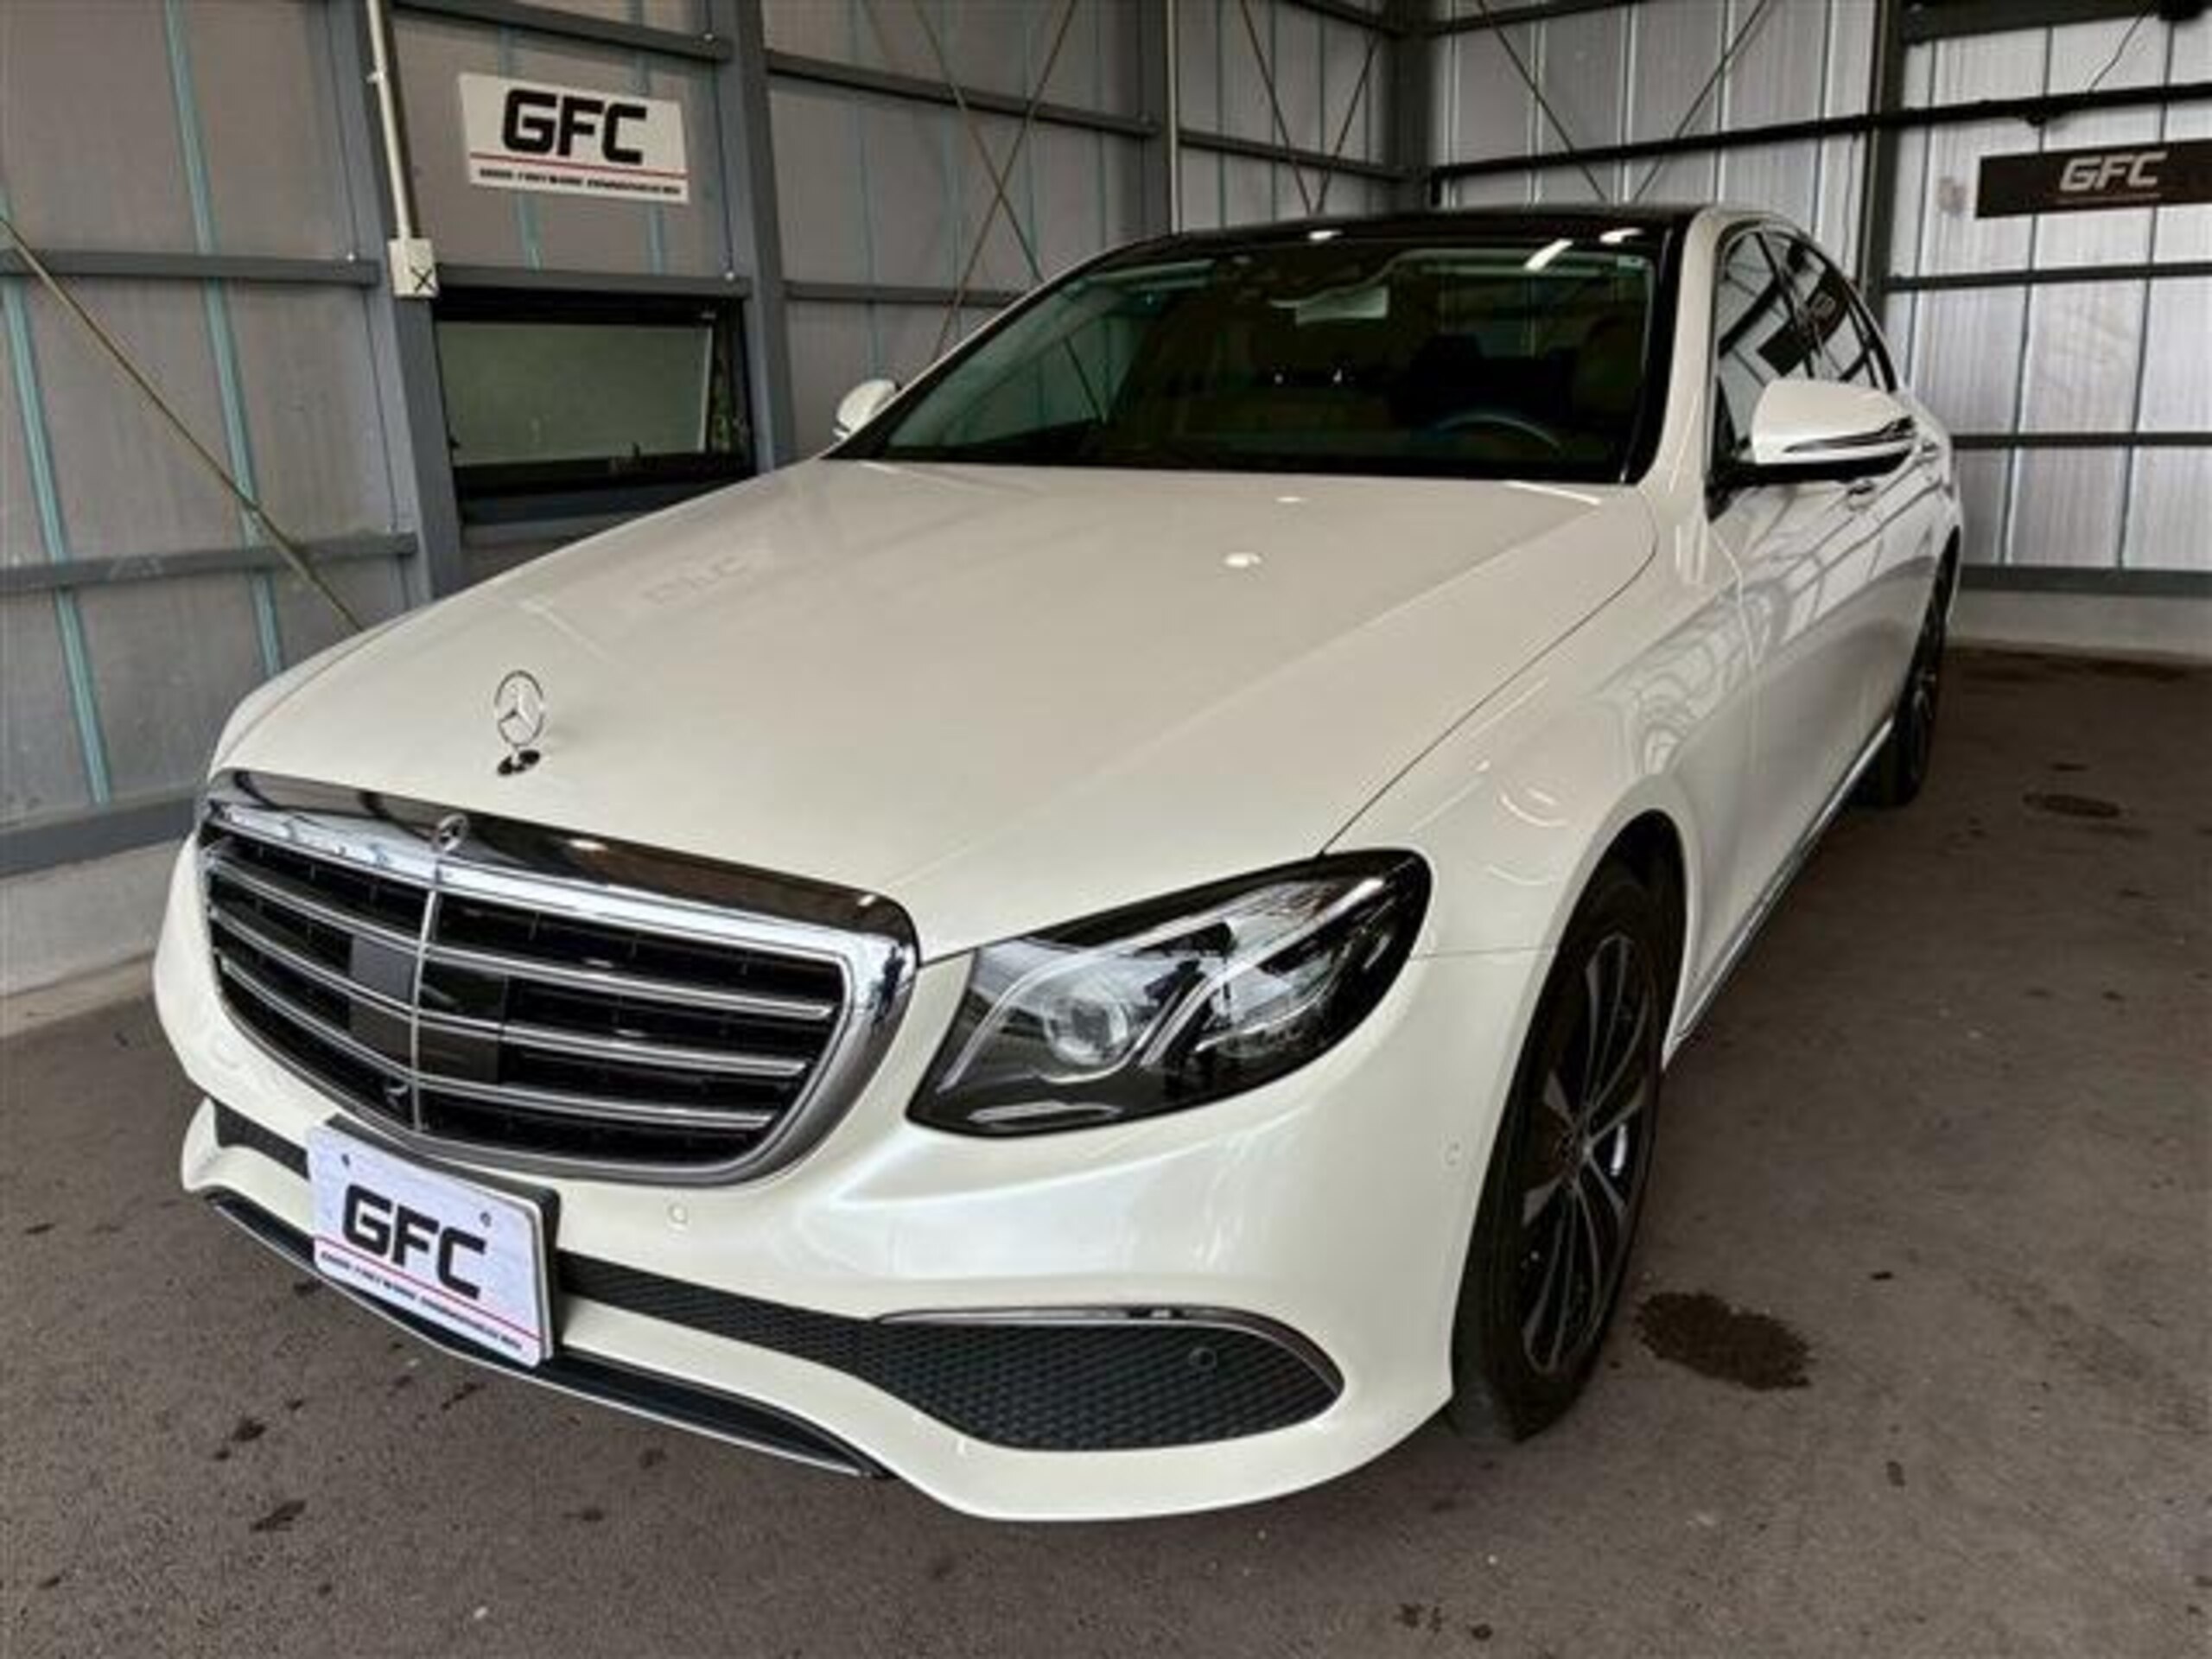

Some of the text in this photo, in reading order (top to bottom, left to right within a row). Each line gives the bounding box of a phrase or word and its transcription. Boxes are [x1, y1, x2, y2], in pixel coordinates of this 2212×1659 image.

[502, 88, 647, 165] GFC
[2059, 150, 2167, 192] GFC
[342, 1183, 486, 1300] GFC
